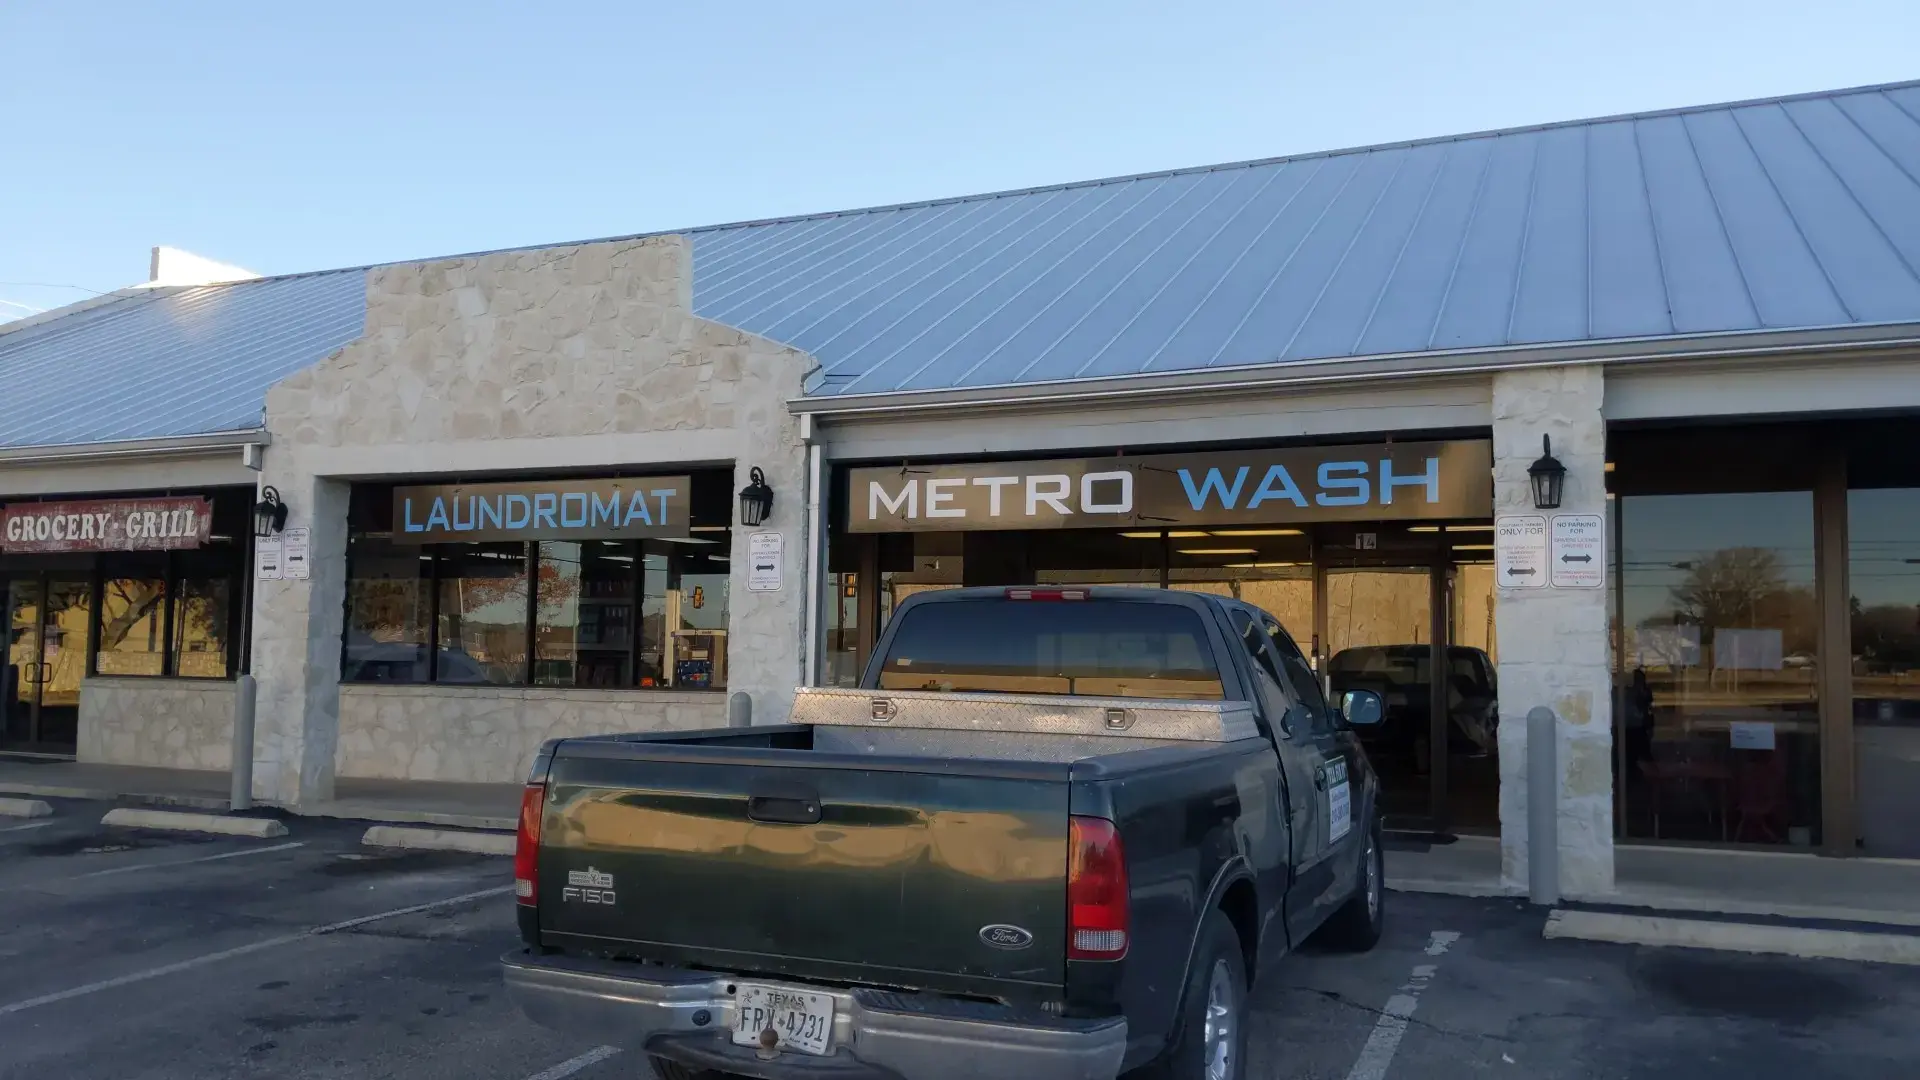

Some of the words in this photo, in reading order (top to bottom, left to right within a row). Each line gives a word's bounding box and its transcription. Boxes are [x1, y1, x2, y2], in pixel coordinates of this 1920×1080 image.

[868, 470, 1133, 520] METRO
[1176, 457, 1439, 511] WASH
[405, 489, 677, 532] LAUNDROMAT
[7, 513, 110, 541] GROCERY
[126, 510, 197, 538] GRILL
[1500, 528, 1522, 536] ONLY
[1525, 527, 1544, 535] FOR
[1358, 534, 1375, 550] 14
[992, 929, 1018, 943] Ford
[767, 993, 805, 1007] TEXAS
